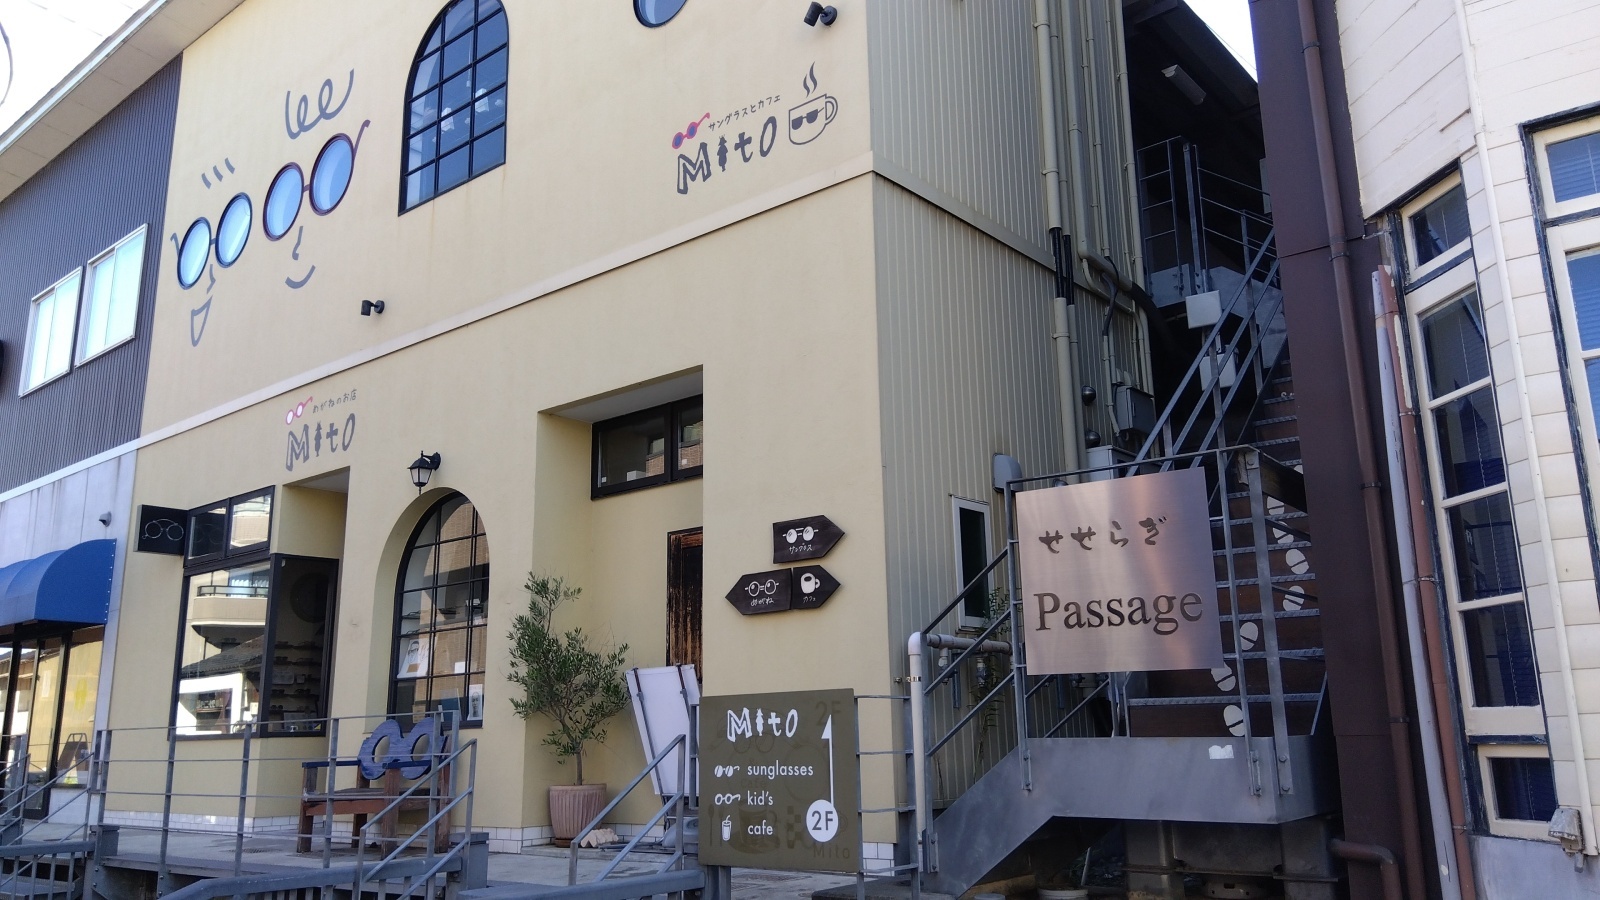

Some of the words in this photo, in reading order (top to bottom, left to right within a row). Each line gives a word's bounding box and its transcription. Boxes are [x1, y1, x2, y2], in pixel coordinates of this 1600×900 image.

[708, 94, 781, 132] サングラスとカフェ
[312, 388, 358, 414] めがねのお店
[1038, 515, 1167, 554] せせらぎ
[750, 596, 775, 607] めがね
[1033, 591, 1204, 636] Passage
[747, 759, 814, 780] sunglasses
[747, 790, 774, 806] kid's
[747, 819, 773, 836] cafe
[811, 810, 834, 831] 2F
